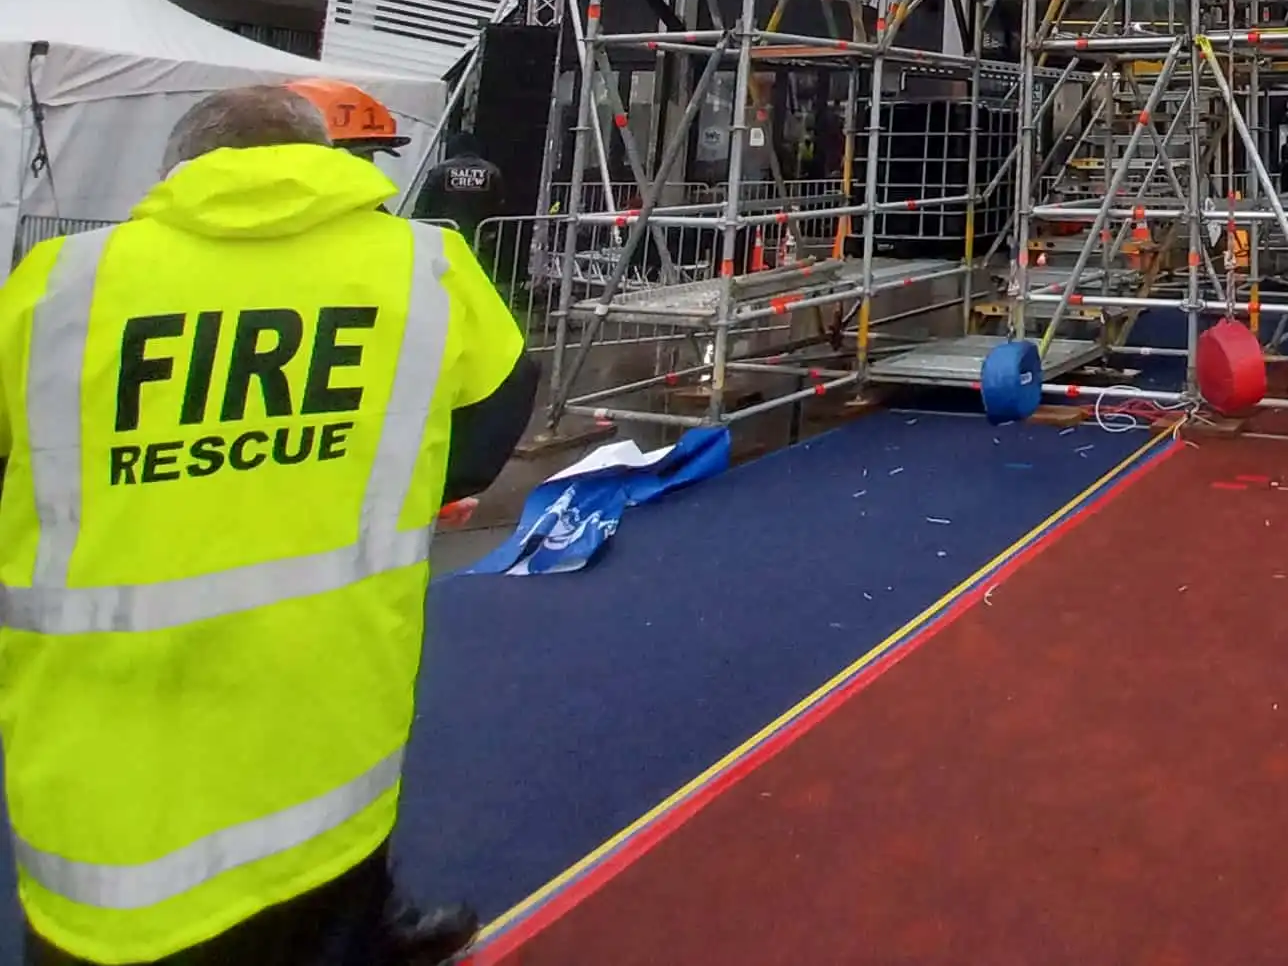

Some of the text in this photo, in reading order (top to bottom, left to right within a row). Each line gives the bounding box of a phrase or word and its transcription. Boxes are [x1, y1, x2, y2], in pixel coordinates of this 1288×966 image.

[450, 169, 487, 179] SALTY
[450, 177, 486, 186] CREW
[115, 306, 379, 433] FIRE
[110, 422, 353, 487] RESCUE
